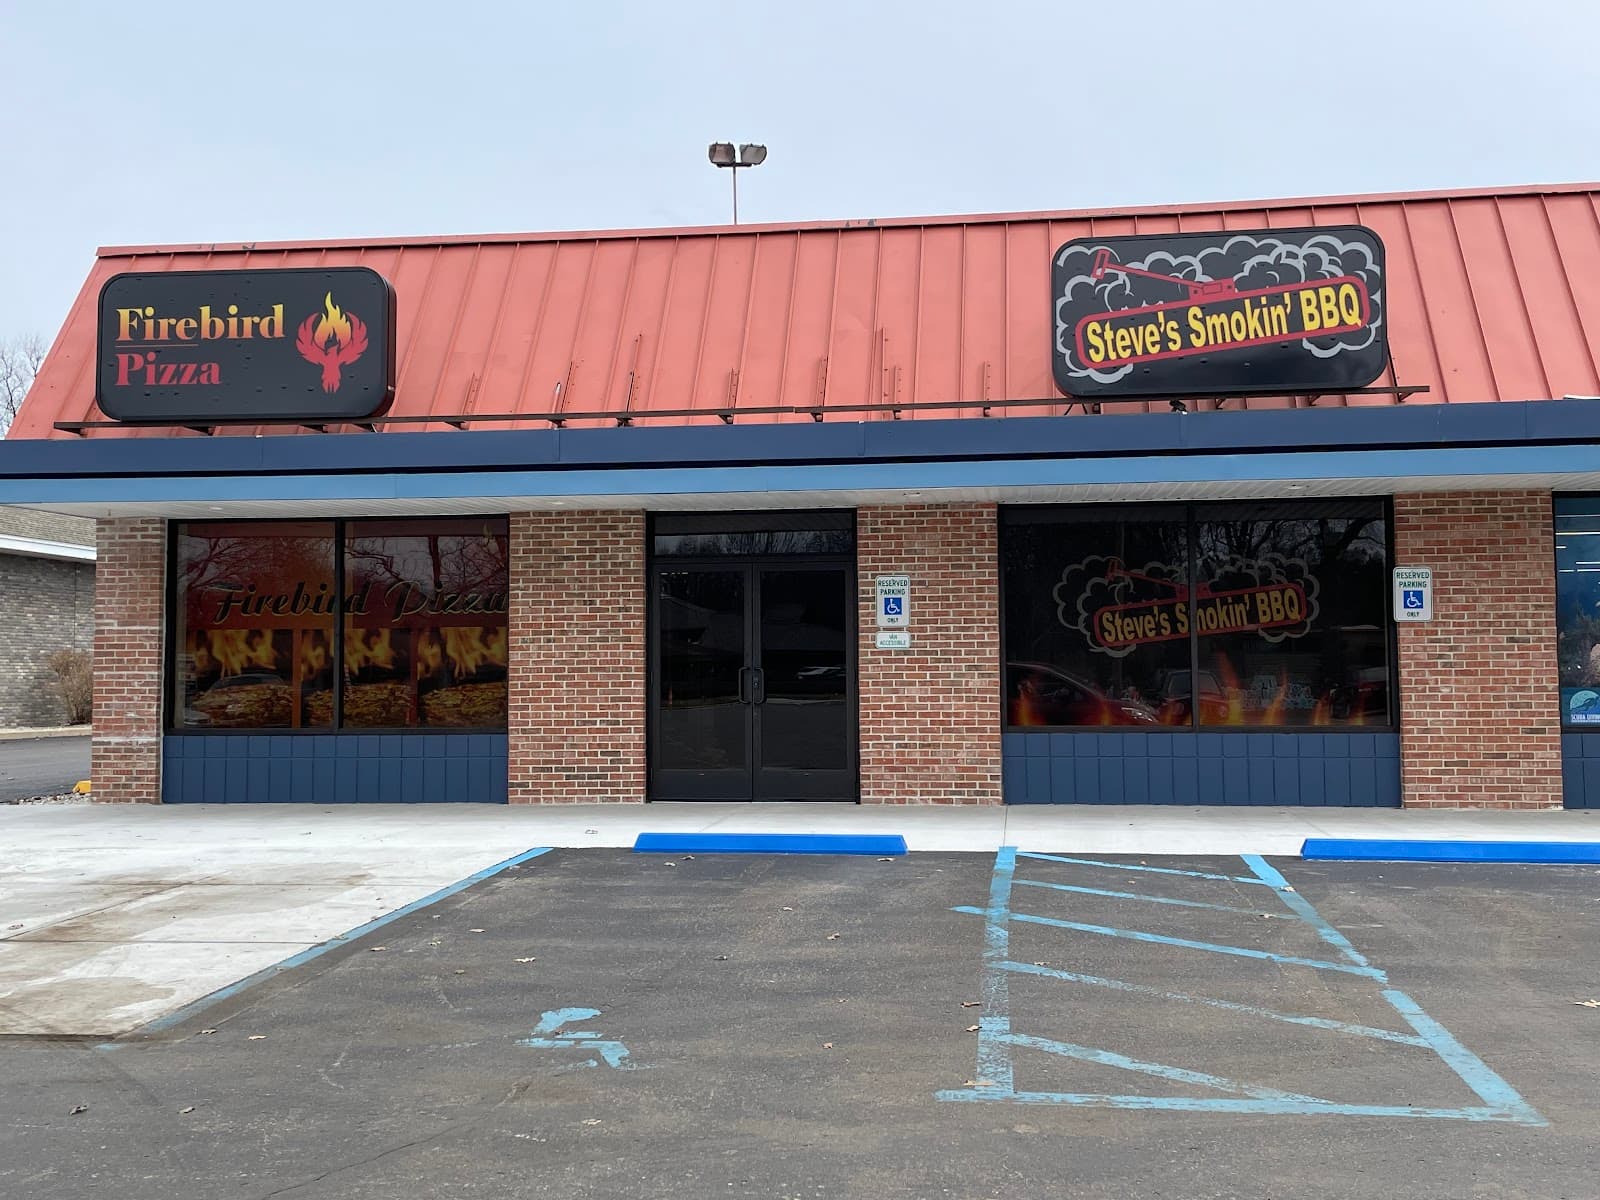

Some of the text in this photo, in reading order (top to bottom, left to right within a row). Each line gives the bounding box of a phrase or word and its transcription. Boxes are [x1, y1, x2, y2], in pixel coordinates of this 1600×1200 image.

[115, 303, 286, 341] Firebird
[1086, 283, 1362, 363] Steve's Smokin' BBQ
[114, 352, 223, 386] Pizza
[877, 579, 907, 587] RESERVED
[1396, 571, 1429, 579] RESERVED
[1102, 605, 1171, 642] Steve's
[1255, 588, 1302, 623] BBQ
